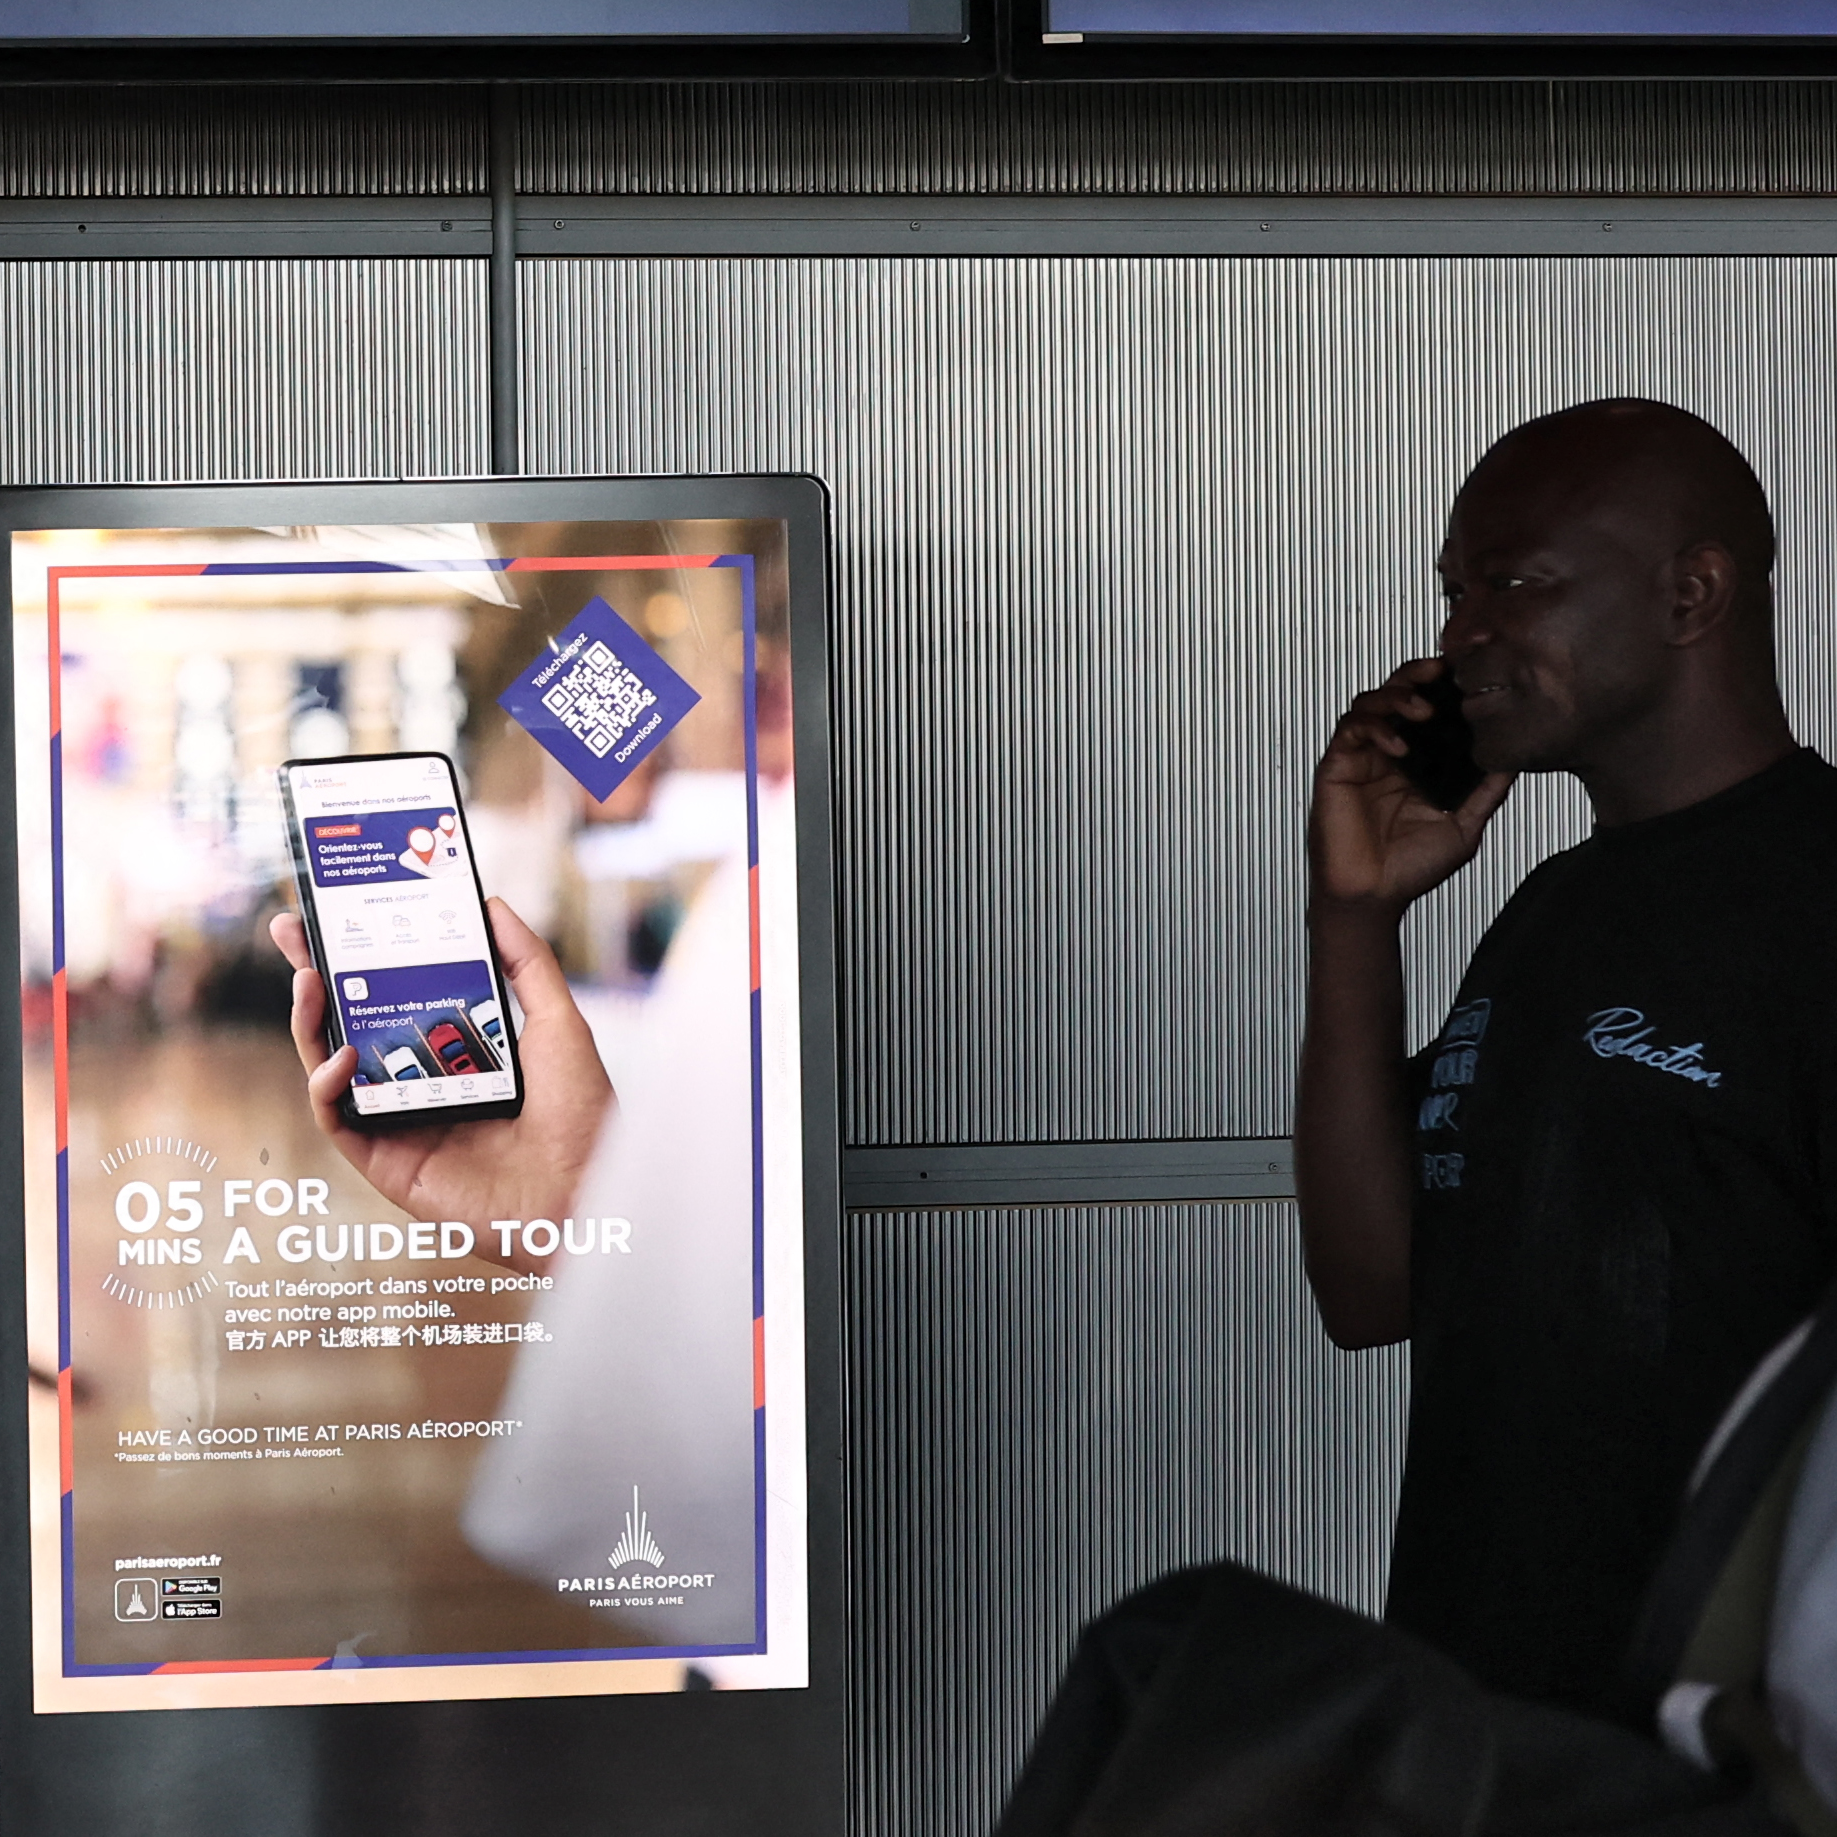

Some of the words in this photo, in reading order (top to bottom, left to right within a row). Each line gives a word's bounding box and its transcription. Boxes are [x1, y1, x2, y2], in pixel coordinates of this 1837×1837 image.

[530, 632, 588, 689] Téléchargez
[614, 713, 663, 764] Download
[348, 1003, 395, 1017] Réservez
[396, 999, 424, 1013] votre
[424, 996, 466, 1011] parking
[1583, 1006, 1722, 1088] Redaction
[115, 1180, 204, 1234] 05
[224, 1178, 330, 1217] FOR
[118, 1237, 202, 1266] MINS
[222, 1226, 261, 1265] A
[276, 1221, 475, 1262] GUIDED
[491, 1217, 634, 1258] TOUR
[224, 1280, 270, 1298] Tout
[379, 1276, 428, 1295] dans
[432, 1275, 486, 1293] votre
[490, 1272, 554, 1297] poche
[225, 1329, 267, 1351] 官方
[271, 1329, 312, 1348] APP
[318, 1322, 554, 1349] 让您将整个机场装进口袋。
[115, 1553, 222, 1572] parisaeroport.fr
